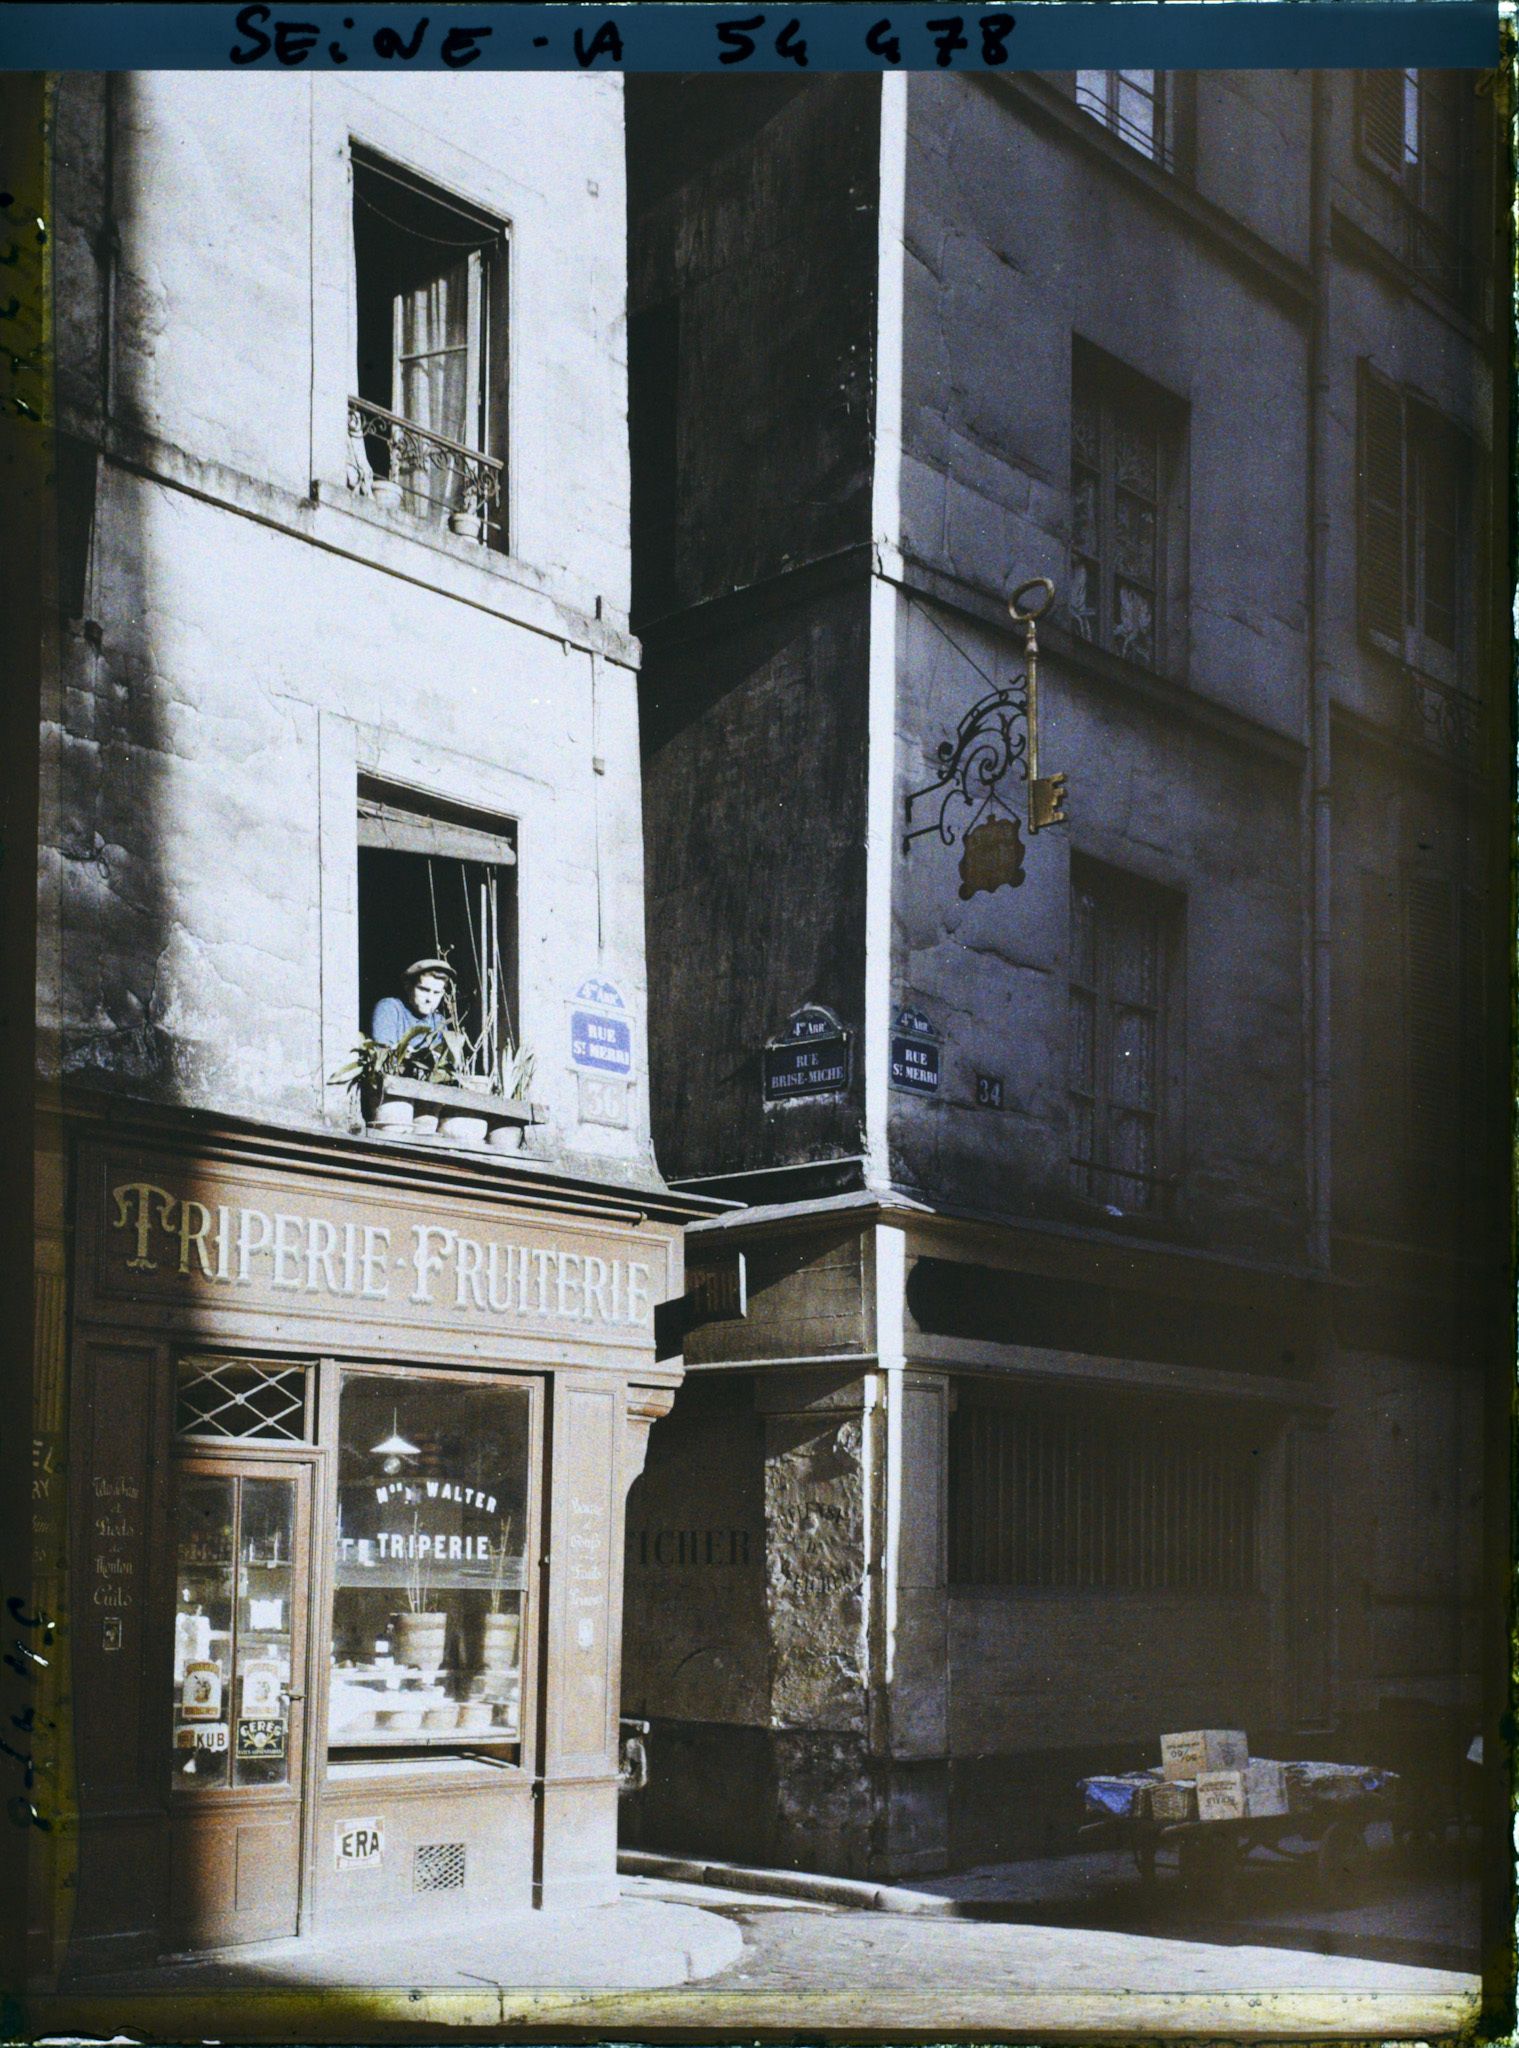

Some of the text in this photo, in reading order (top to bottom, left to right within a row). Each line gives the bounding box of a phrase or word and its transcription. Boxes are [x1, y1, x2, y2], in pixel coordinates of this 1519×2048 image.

[588, 1024, 616, 1043] RUE
[796, 1052, 819, 1069] RUE
[905, 1049, 928, 1066] RUE
[771, 1066, 844, 1089] BRISE-MICHE
[905, 1066, 938, 1085] MERRI
[980, 1078, 1000, 1106] 34
[112, 1182, 652, 1329] TRIPERIE FRUITERIE
[426, 1481, 497, 1514] WALTER
[377, 1532, 489, 1561] TRIPERIE
[196, 1732, 225, 1749] KUB
[342, 1830, 379, 1858] ERA
